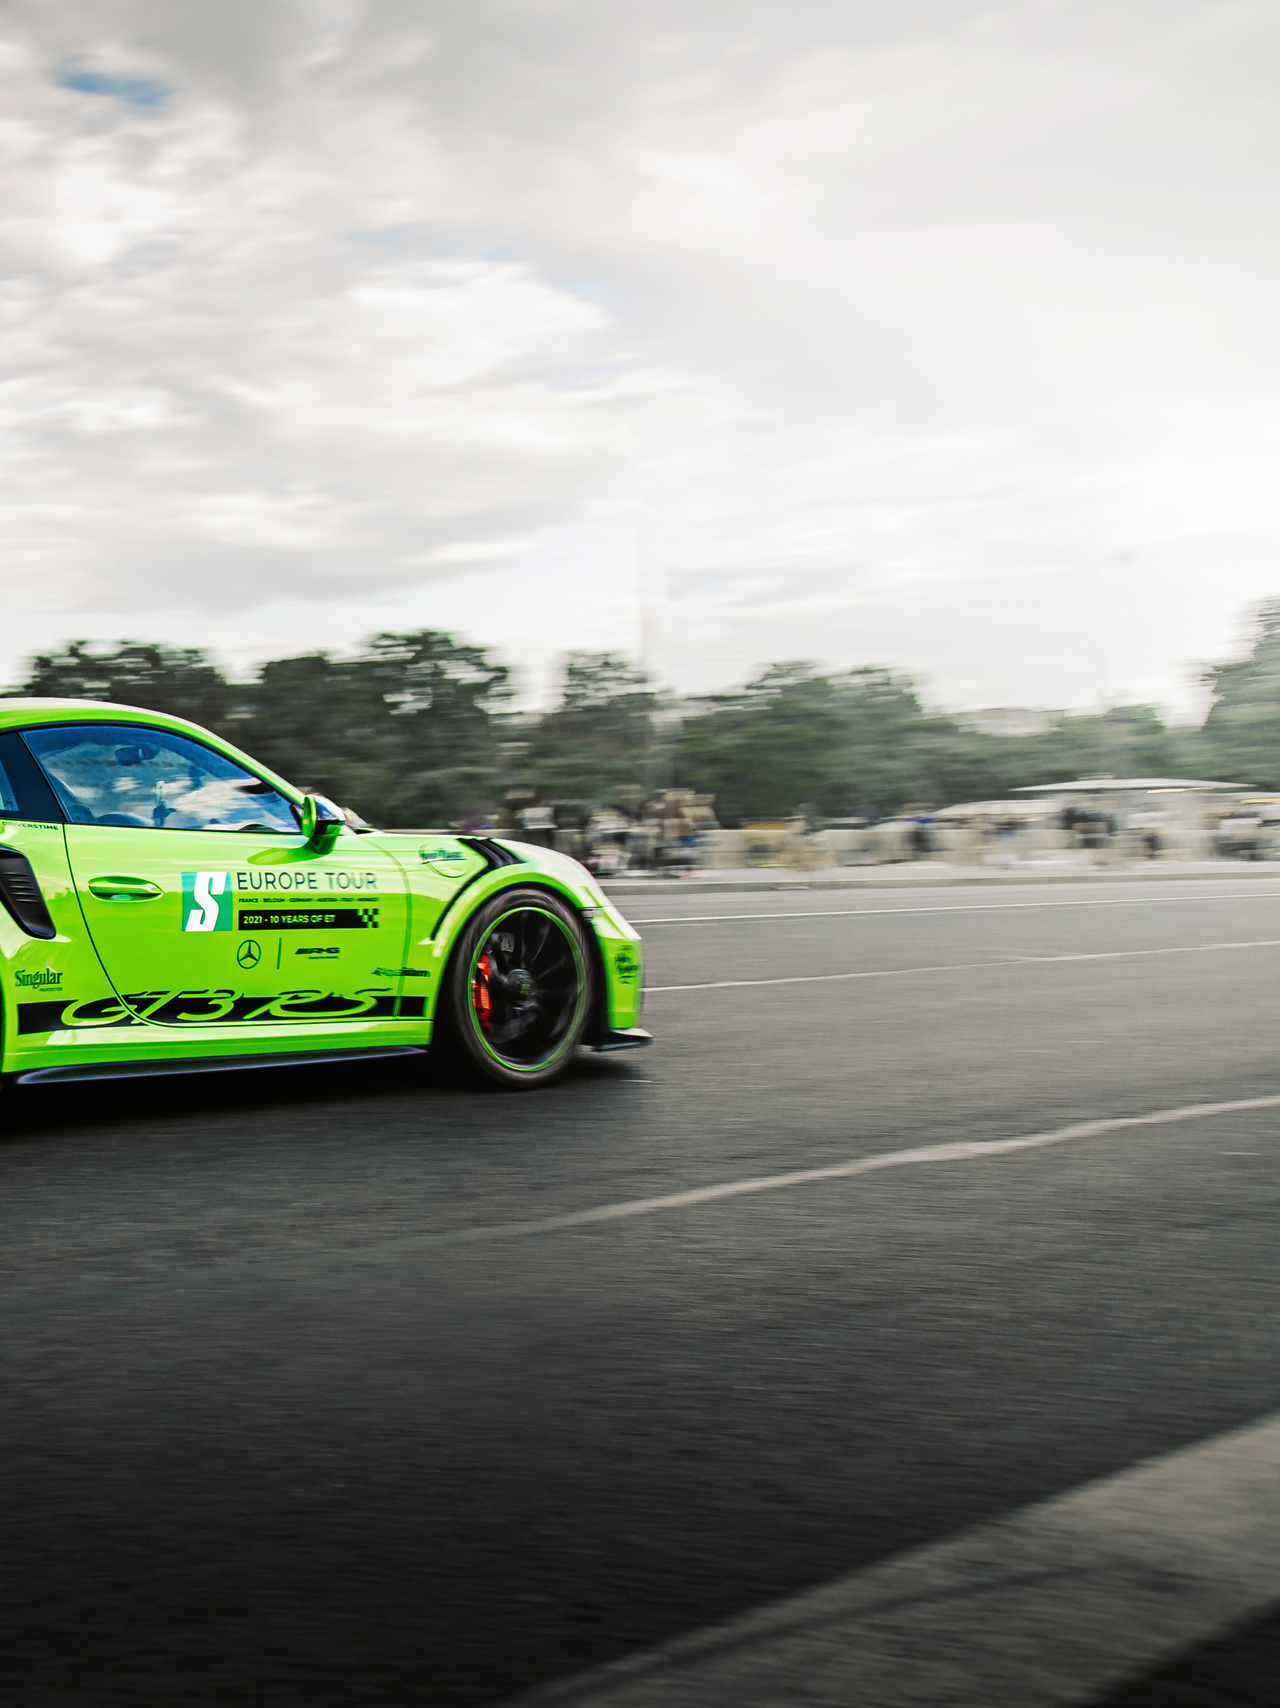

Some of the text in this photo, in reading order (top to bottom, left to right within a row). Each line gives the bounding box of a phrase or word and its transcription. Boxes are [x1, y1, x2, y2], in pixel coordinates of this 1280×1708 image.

[2, 821, 58, 830] DRIVERSTIME
[237, 872, 379, 890] EUROPE TOUR
[243, 915, 263, 924] 2021
[270, 915, 280, 924] 10
[281, 915, 309, 923] YEARS
[310, 914, 323, 923] OF
[324, 914, 336, 923] ET
[306, 947, 340, 955] AMG
[14, 967, 63, 989] Singular
[61, 988, 394, 1026] GT3 RS
